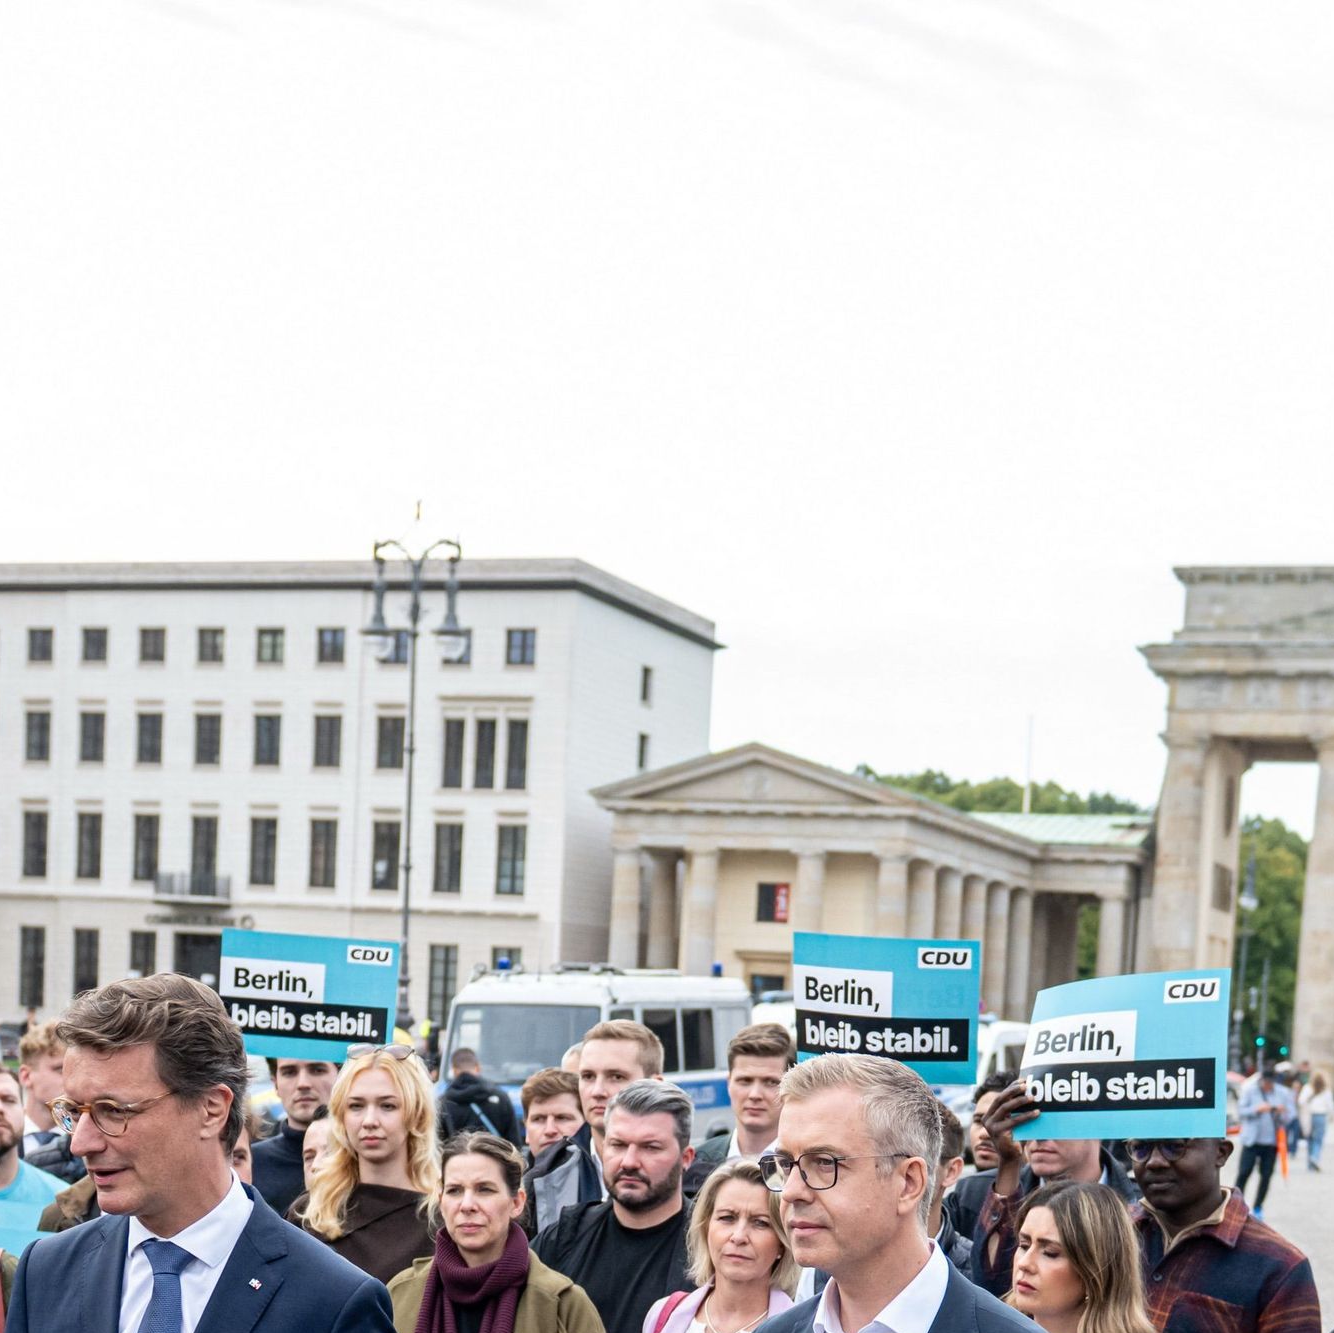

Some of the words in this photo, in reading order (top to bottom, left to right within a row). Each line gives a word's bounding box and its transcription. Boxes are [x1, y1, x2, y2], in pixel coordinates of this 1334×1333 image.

[350, 949, 390, 962] CDU
[921, 950, 968, 966] CDU
[234, 967, 314, 998] Berlin,
[804, 976, 881, 1013] Berlin,
[1167, 982, 1216, 999] CDU
[231, 1002, 296, 1031] bleib
[300, 1011, 378, 1038] stabil.
[805, 1019, 861, 1050] bleib
[865, 1025, 958, 1054] stabil.
[1033, 1023, 1122, 1056] Berlin,
[1025, 1066, 1100, 1102] bleib
[1106, 1066, 1204, 1100] stabil.
